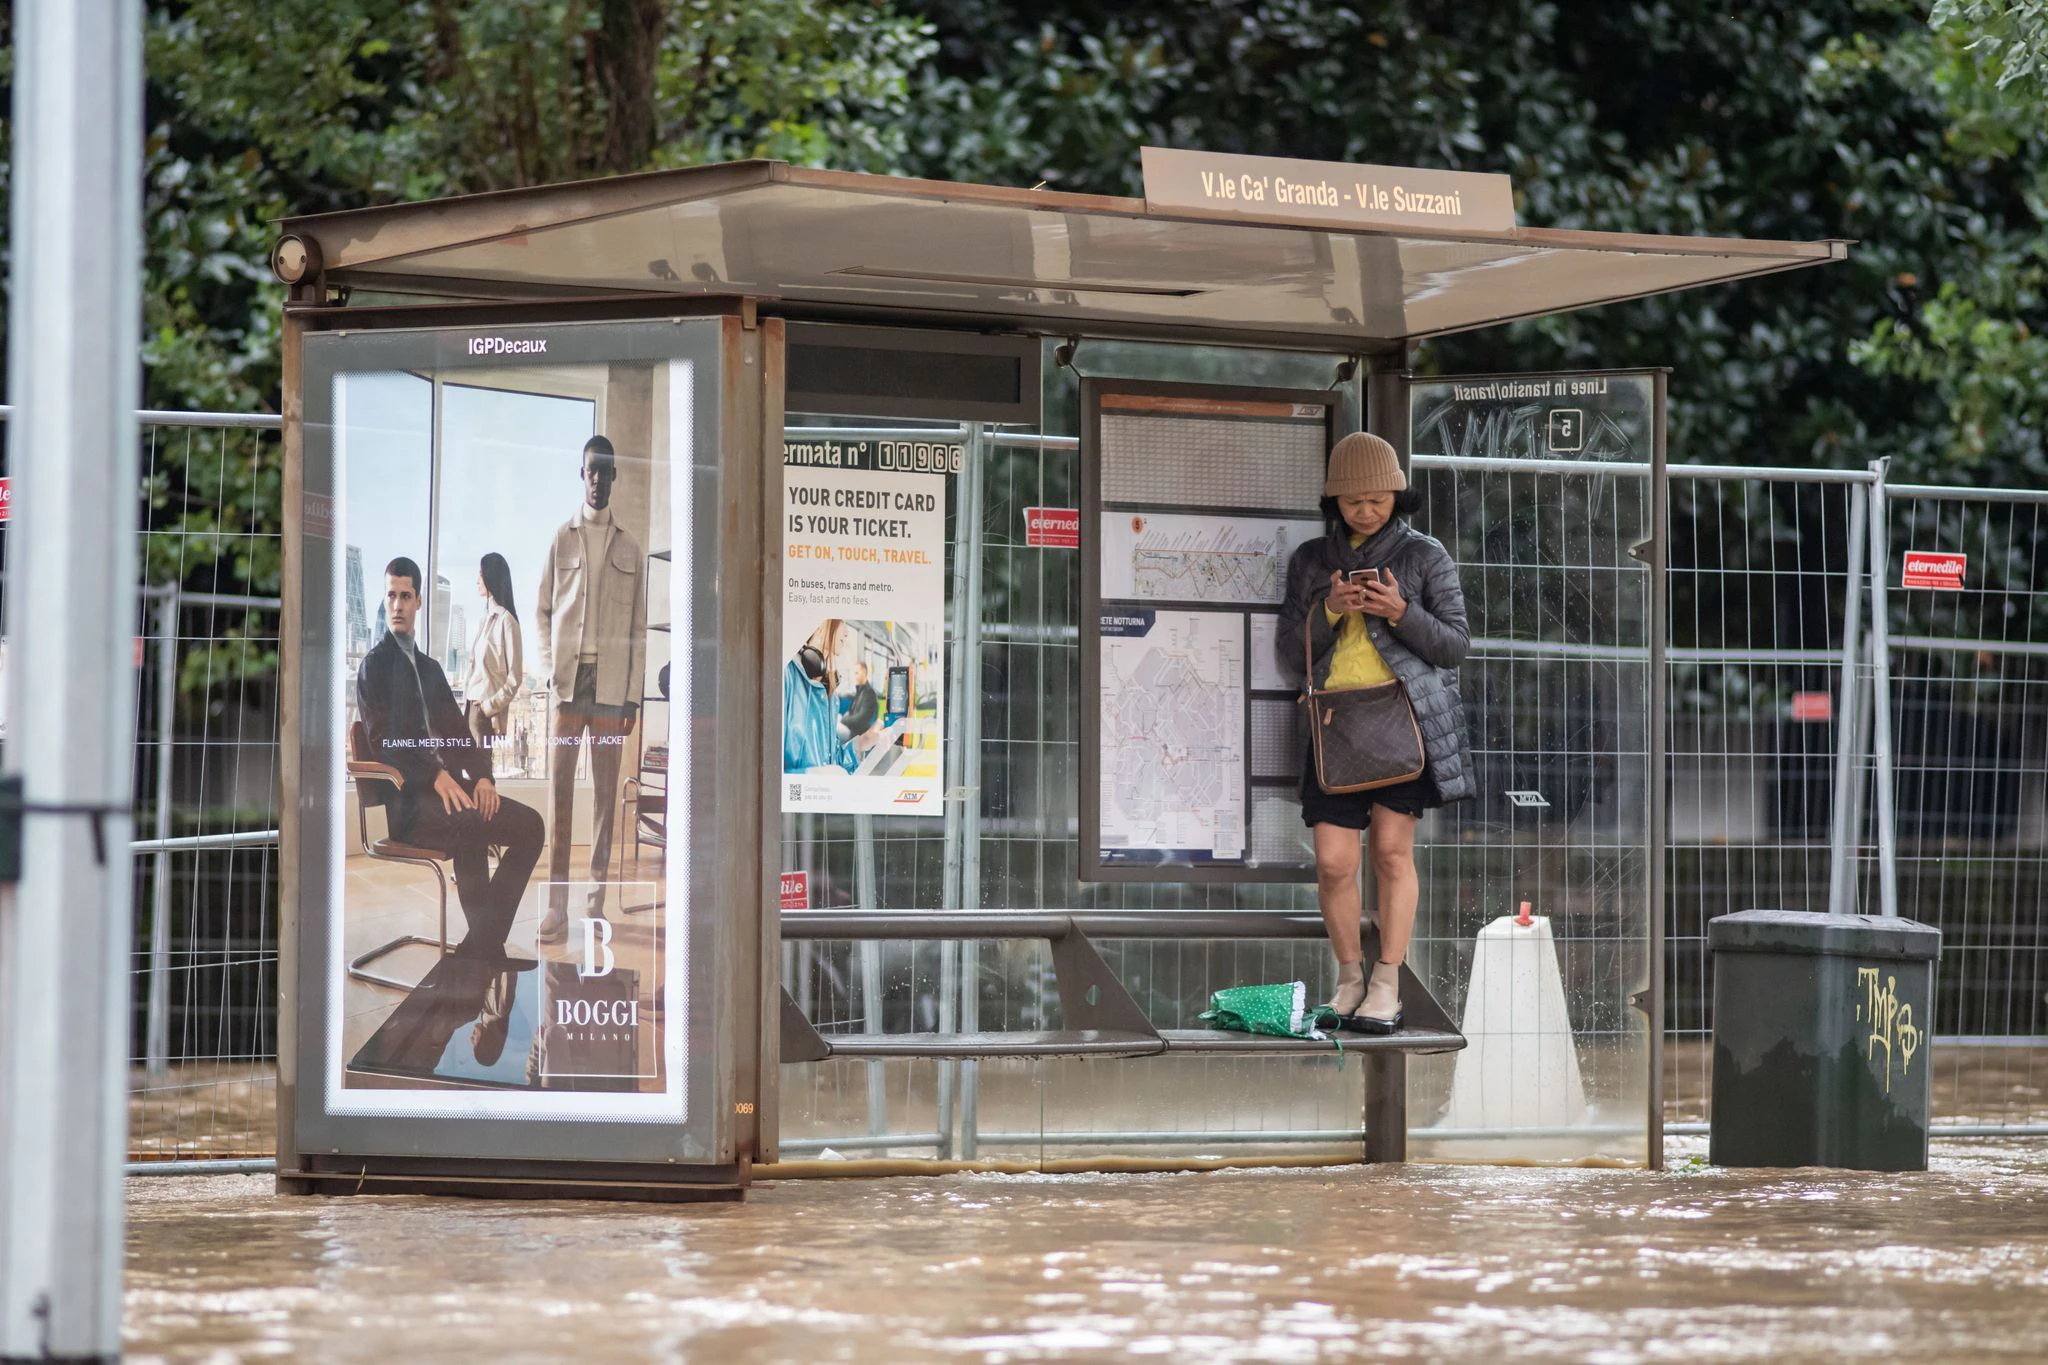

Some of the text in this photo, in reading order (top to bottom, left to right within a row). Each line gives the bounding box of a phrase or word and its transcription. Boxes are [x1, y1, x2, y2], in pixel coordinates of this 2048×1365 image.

[1201, 171, 1236, 199] V.le
[1240, 174, 1268, 201] Ca'
[1275, 177, 1338, 206] Granda
[1355, 183, 1389, 210] V.le
[1394, 186, 1462, 216] Suzzani
[468, 337, 547, 354] IGPDecaux
[847, 442, 867, 466] n°
[789, 487, 935, 512] YOUR CREDIT CARD
[789, 514, 911, 538] IS YOUR TICKET.
[789, 544, 932, 565] GET ON, TOUCH, TRAVEL.
[1908, 560, 1963, 574] eternedile
[788, 578, 894, 592] On buses, trams and metro.
[788, 592, 808, 604] Easy,
[809, 593, 824, 603] fast
[825, 594, 840, 604] and
[841, 596, 851, 605] no
[1113, 617, 1145, 626] NOTTURNA
[382, 738, 417, 748] FLANNEL
[418, 738, 445, 748] MEETS
[446, 737, 471, 747] STYLE
[597, 735, 626, 745] JACKET
[580, 917, 615, 977] B
[556, 999, 639, 1026] BOGGI
[567, 1032, 631, 1041] MILANO
